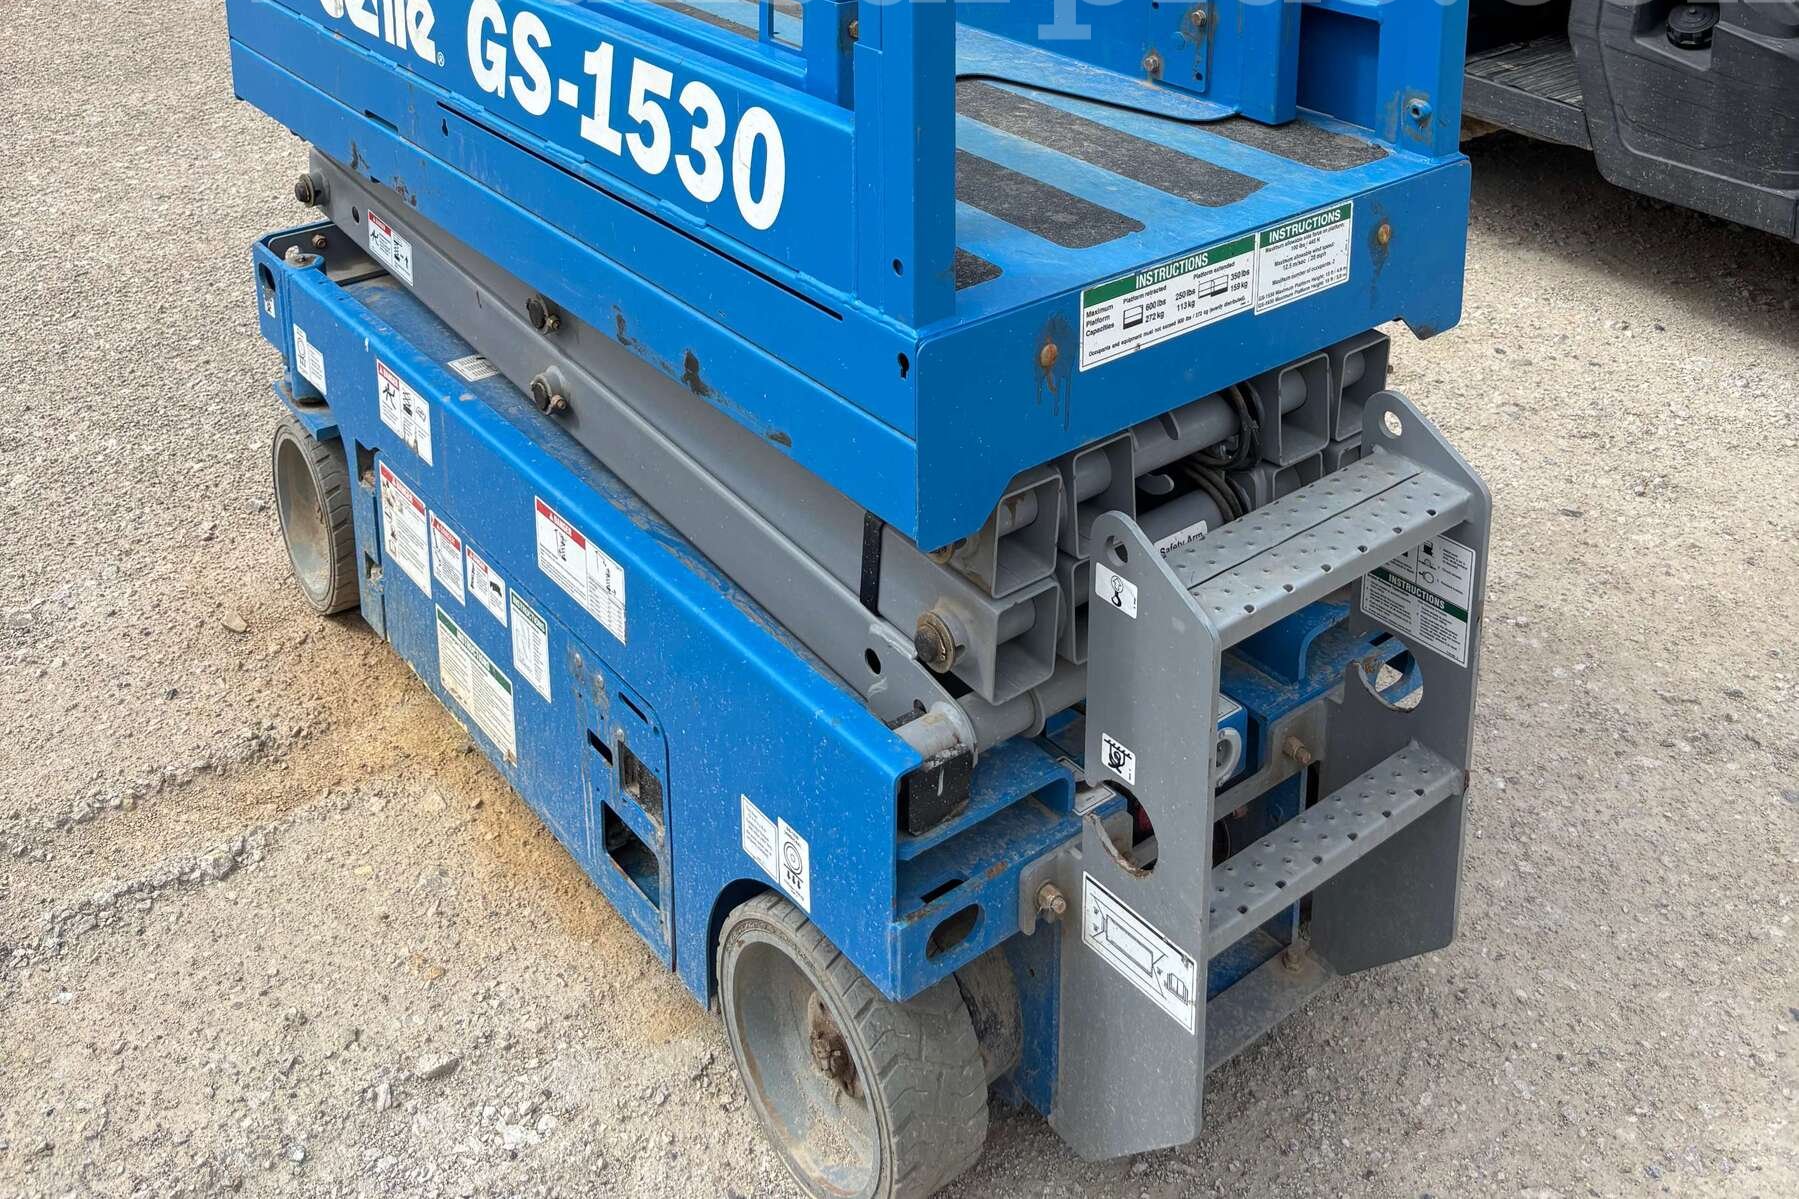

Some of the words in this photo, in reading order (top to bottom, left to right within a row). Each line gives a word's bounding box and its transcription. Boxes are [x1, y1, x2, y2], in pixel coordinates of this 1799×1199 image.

[1269, 209, 1341, 243] INSTRUCTIONS
[1135, 252, 1209, 290] INSTRUCTIONS
[1086, 304, 1114, 318] Maximum
[1145, 313, 1156, 323] 272
[1156, 311, 1165, 320] kg
[1086, 315, 1111, 327] Platform
[1085, 323, 1115, 337] Capacities
[1388, 573, 1446, 610] INSTRUCTIONS
